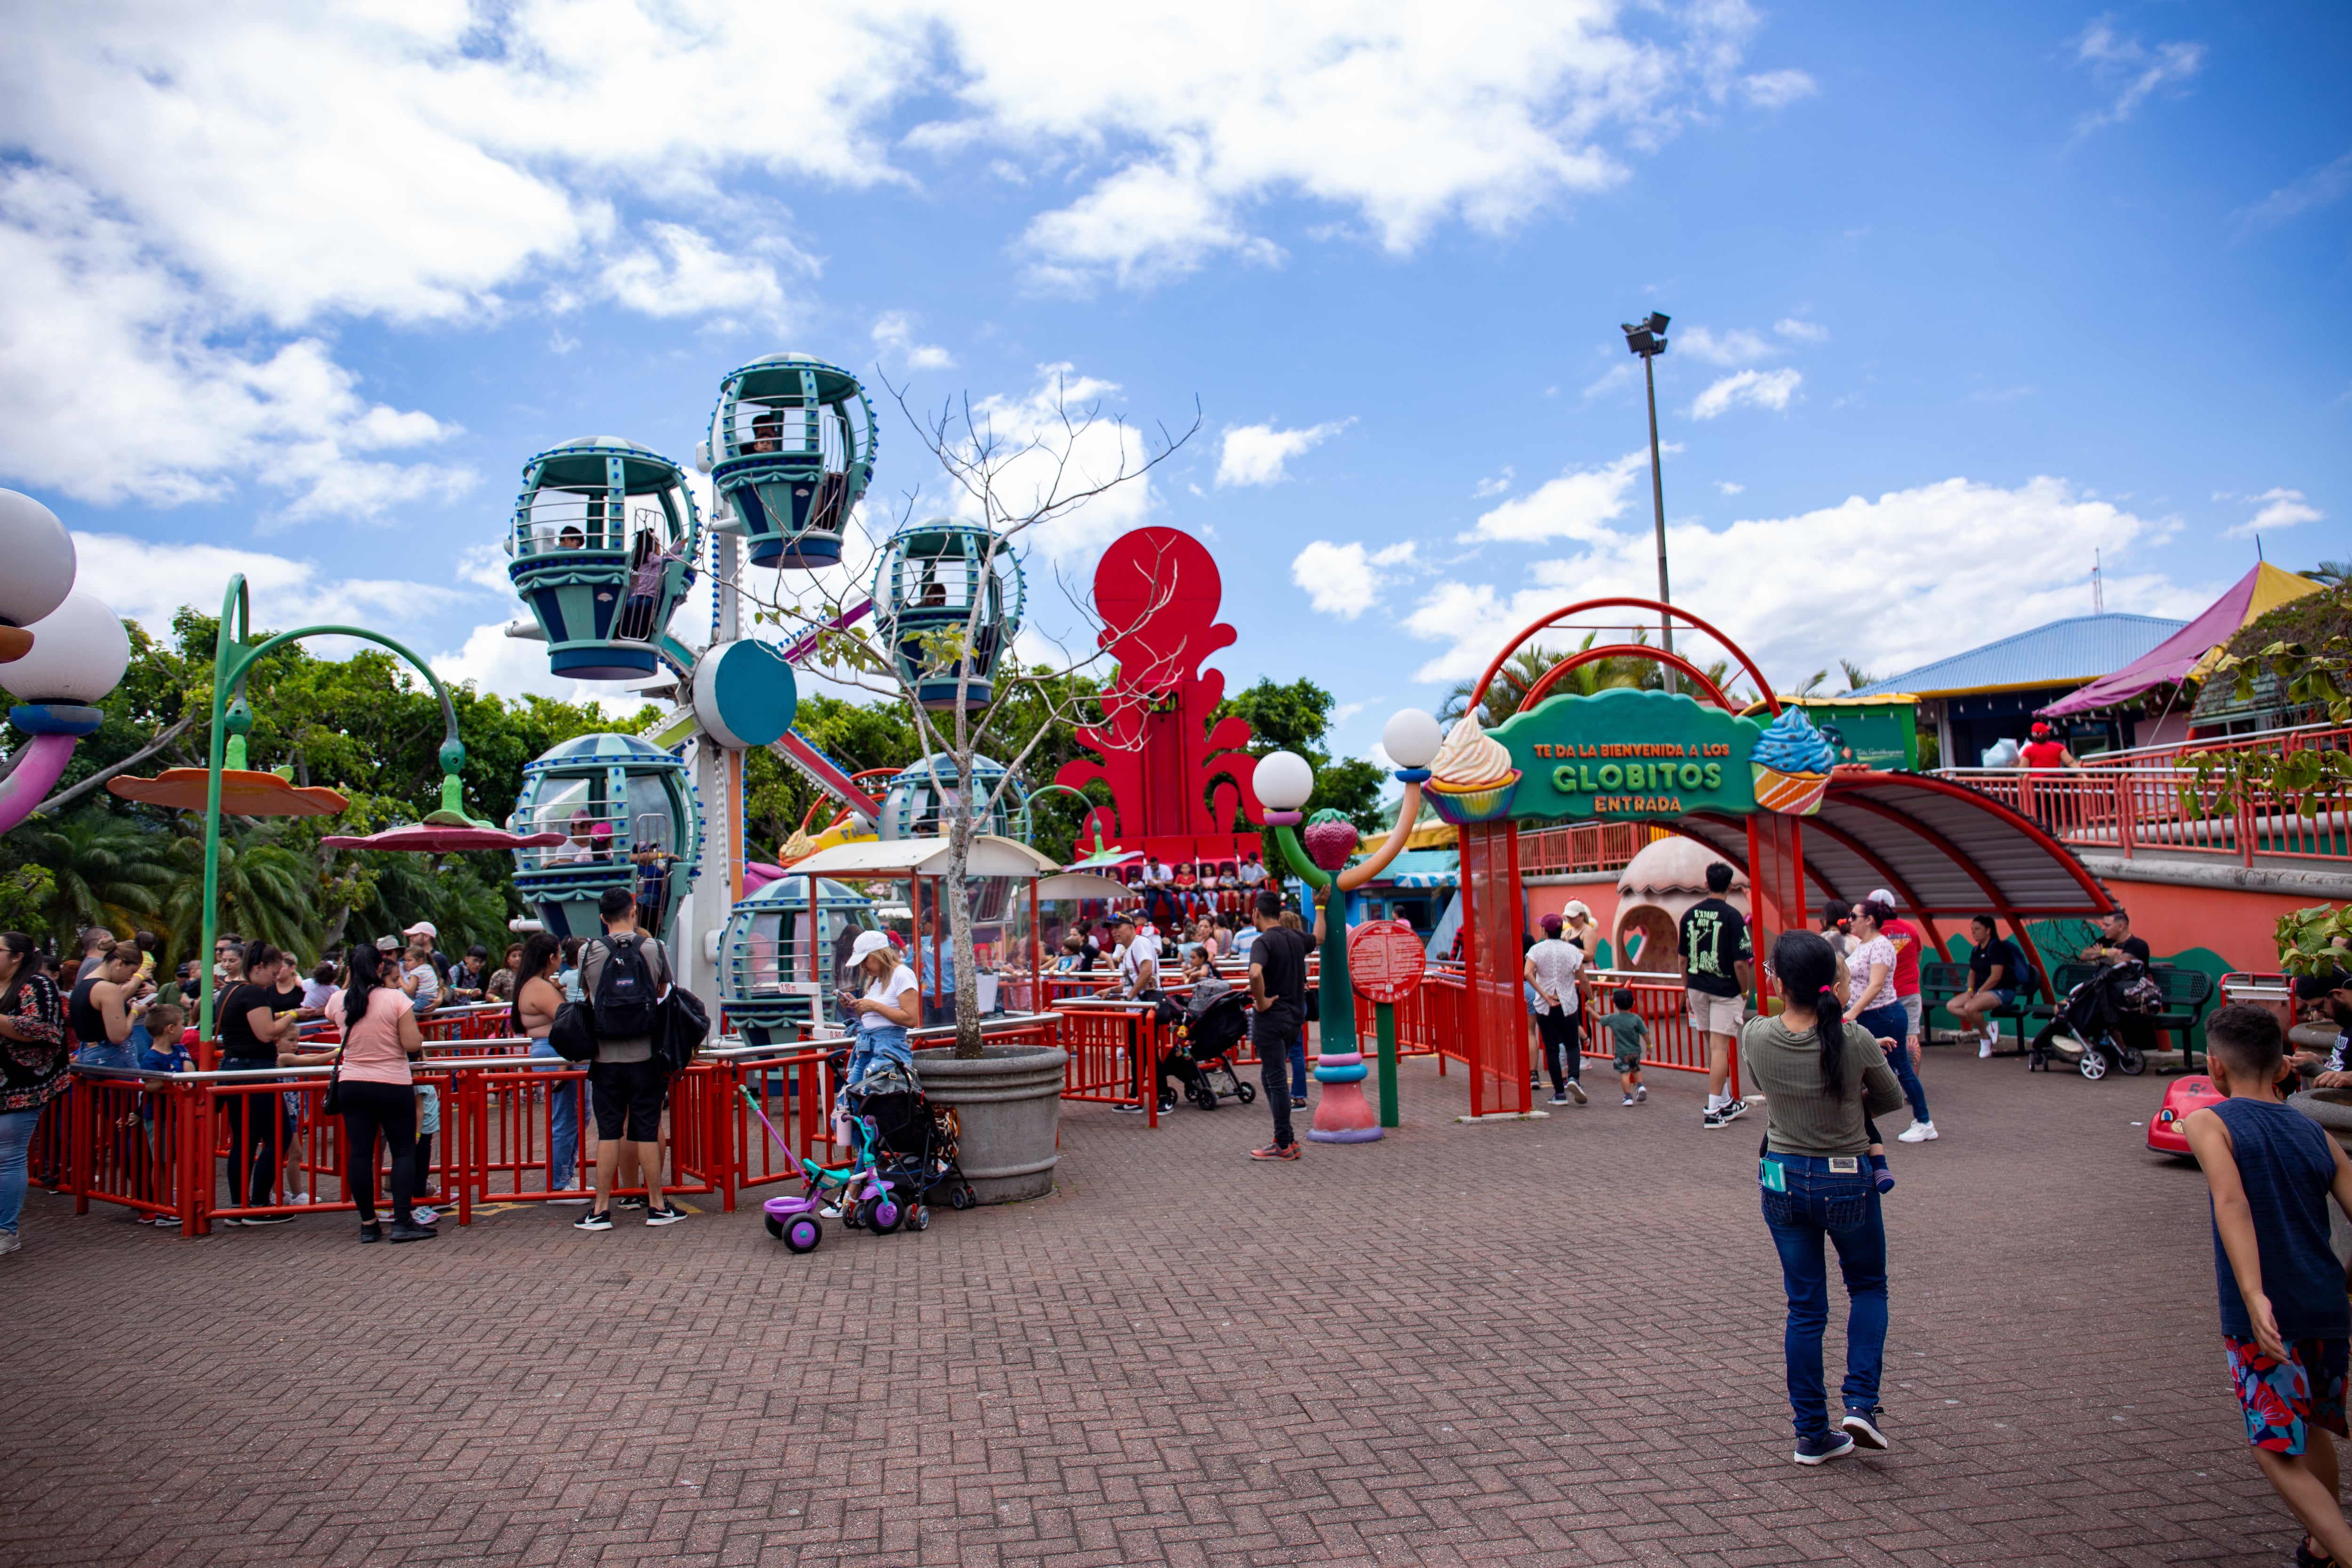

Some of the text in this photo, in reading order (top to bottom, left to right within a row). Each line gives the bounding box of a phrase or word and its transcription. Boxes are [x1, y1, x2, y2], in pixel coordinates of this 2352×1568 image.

[1534, 743, 1730, 758] TE DA LA BIENVENIDA A LOS
[1553, 763, 1721, 793] GLOBITOS
[1594, 796, 1682, 812] ENTRADA
[1694, 909, 1719, 920] EXPAND
[781, 983, 791, 993] 1.10
